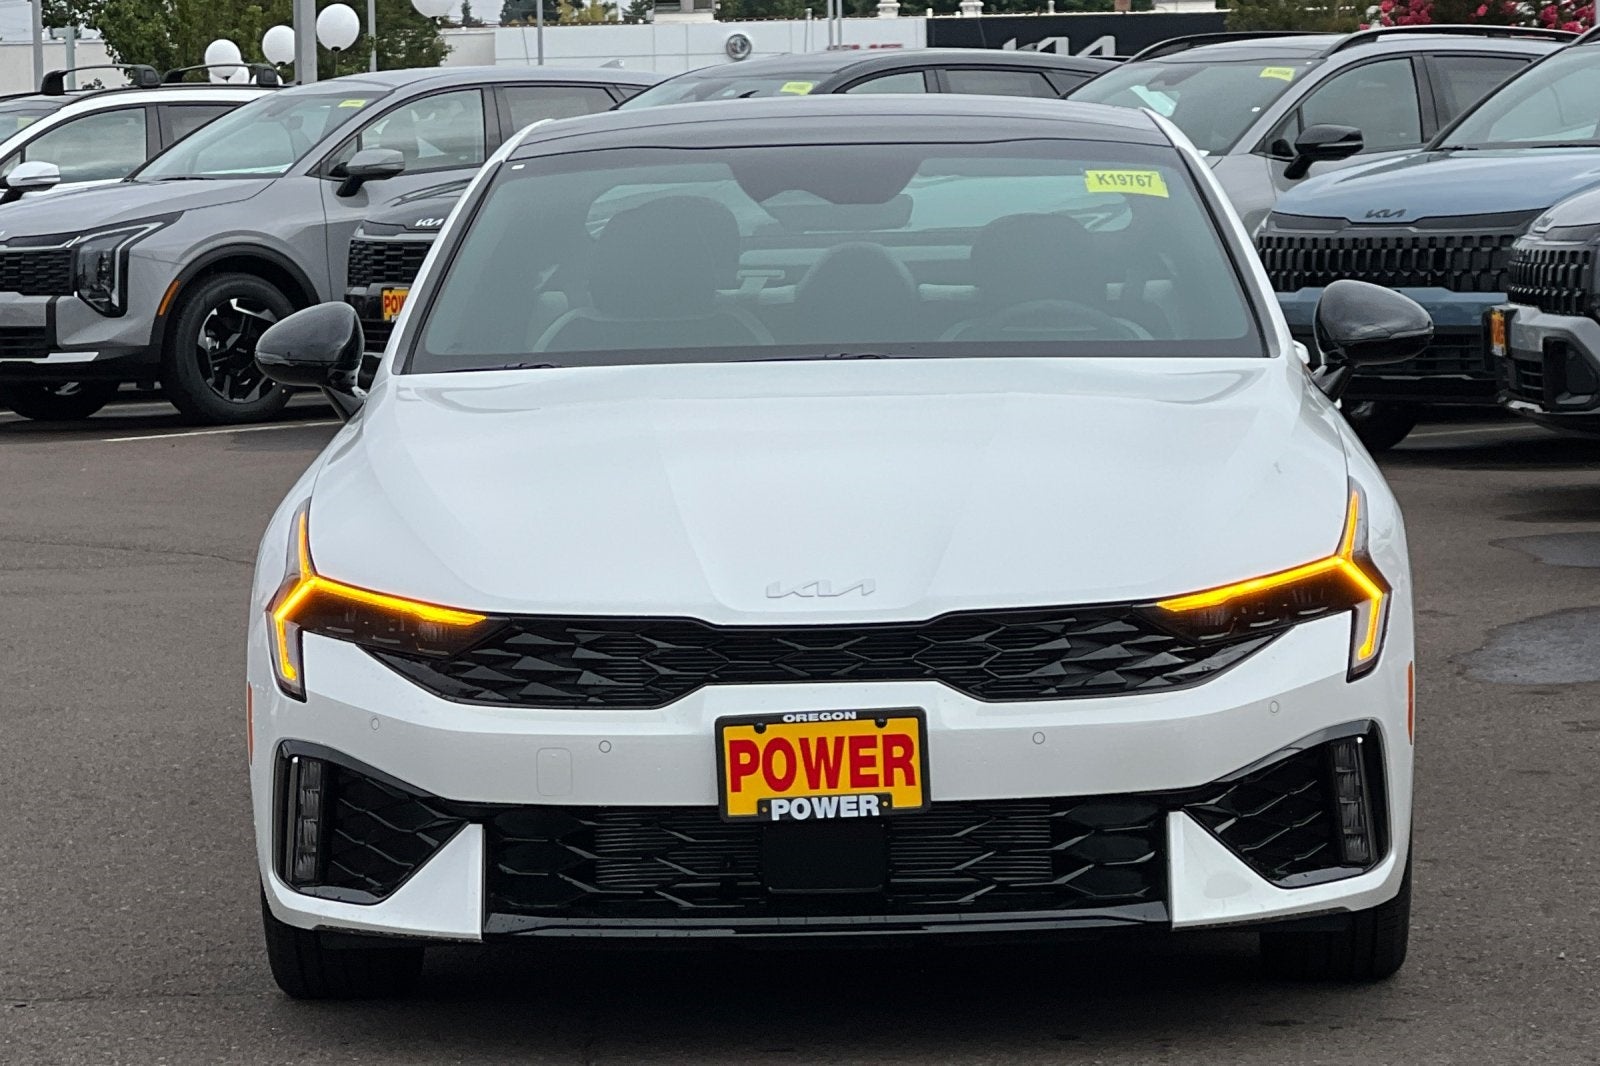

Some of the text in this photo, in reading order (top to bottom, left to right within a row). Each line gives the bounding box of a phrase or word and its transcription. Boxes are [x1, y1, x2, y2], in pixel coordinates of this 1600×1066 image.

[1095, 173, 1153, 188] K19767
[1365, 208, 1407, 218] KIA
[414, 218, 445, 227] KIA
[766, 578, 876, 598] KIA
[782, 711, 857, 723] OREGON
[728, 733, 916, 793] POWER
[771, 795, 880, 821] POWER
